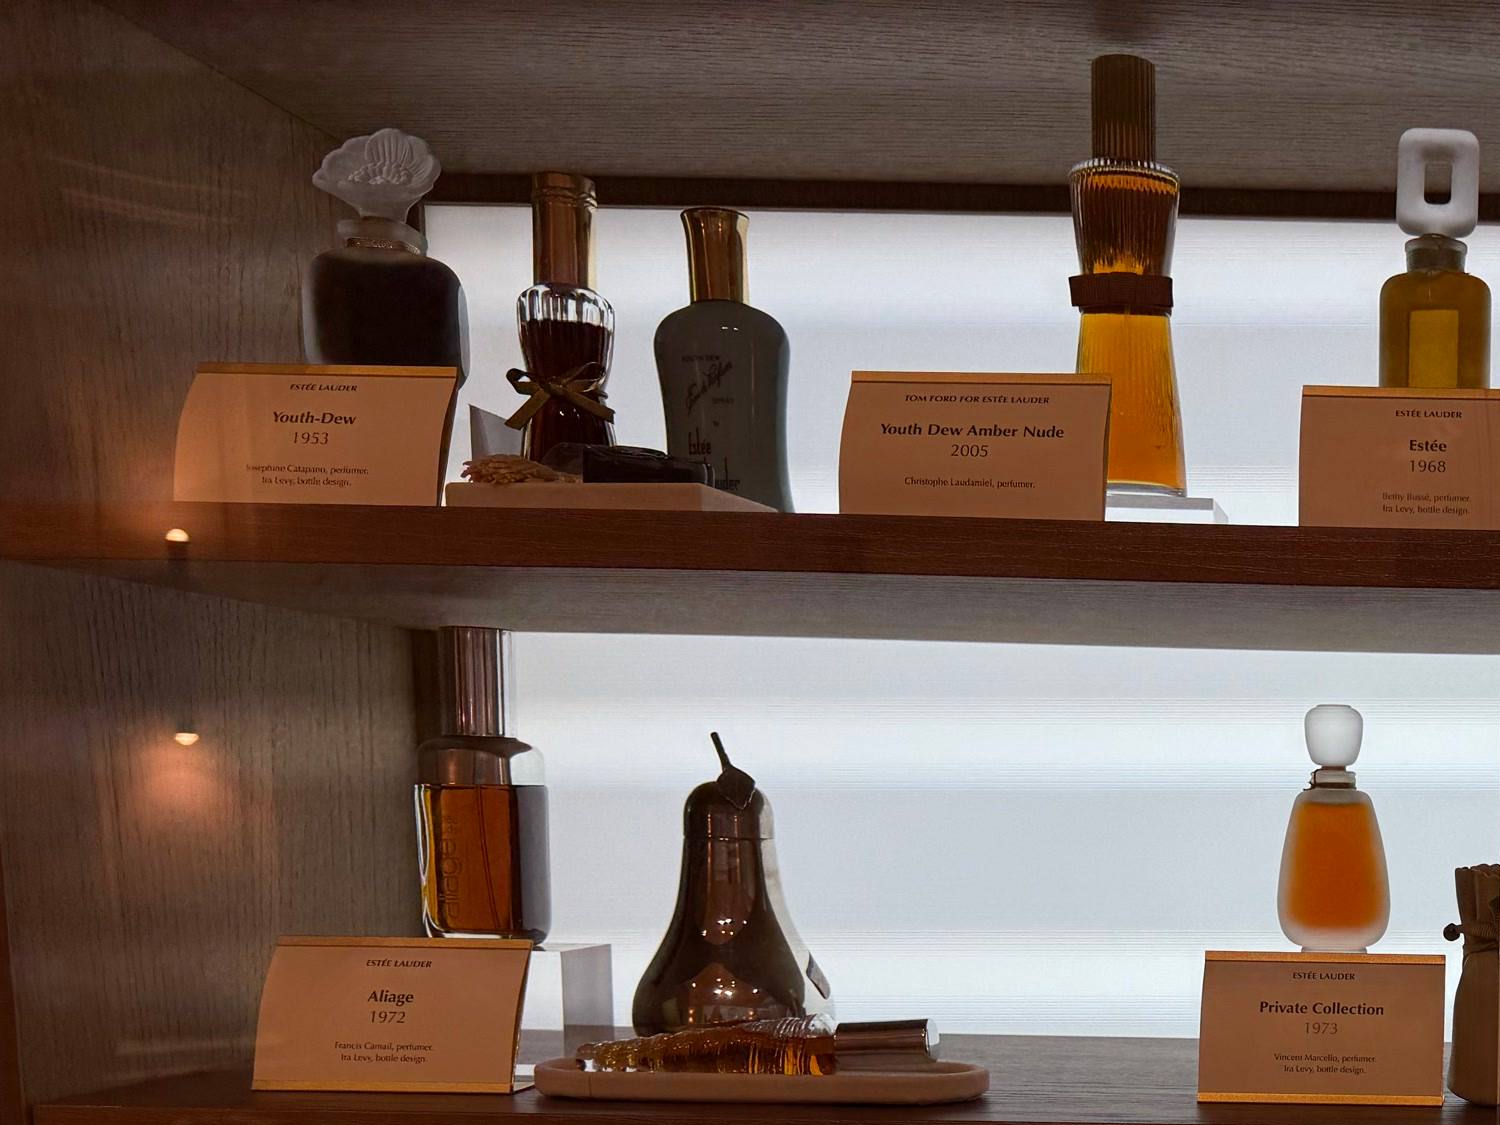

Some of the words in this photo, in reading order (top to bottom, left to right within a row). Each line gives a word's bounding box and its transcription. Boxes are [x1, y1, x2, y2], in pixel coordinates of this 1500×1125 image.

[319, 384, 358, 392] LAUDER
[905, 394, 927, 402] TOM
[960, 395, 980, 403] FOR
[982, 395, 1008, 403] ESTÉE
[1011, 396, 1049, 404] LAUDER
[273, 411, 356, 425] Youth-Dew
[1395, 409, 1421, 418] ESTÉE
[1424, 410, 1463, 419] LAUDER
[881, 423, 922, 435] Youth
[928, 424, 963, 436] Dew
[967, 424, 1018, 437] Amber
[1024, 426, 1064, 438] Nude
[293, 432, 329, 445] 1953
[951, 444, 989, 457] 2005
[1410, 439, 1447, 452] Estée
[1410, 460, 1446, 472] 1968
[905, 477, 949, 487] Christophe
[1417, 505, 1442, 513] bottle
[441, 839, 463, 919] aliage
[366, 959, 392, 967] ESTÉE
[394, 960, 432, 968] LAUDER
[1293, 971, 1317, 980] ESTÉE
[1320, 972, 1355, 980] LAUDER
[368, 990, 414, 1006] Aliage
[1260, 1001, 1308, 1014] Private
[1312, 1002, 1384, 1015] Collection
[371, 1010, 406, 1024] 1972
[1305, 1022, 1338, 1034] 1973
[1317, 1065, 1338, 1073] bottle
